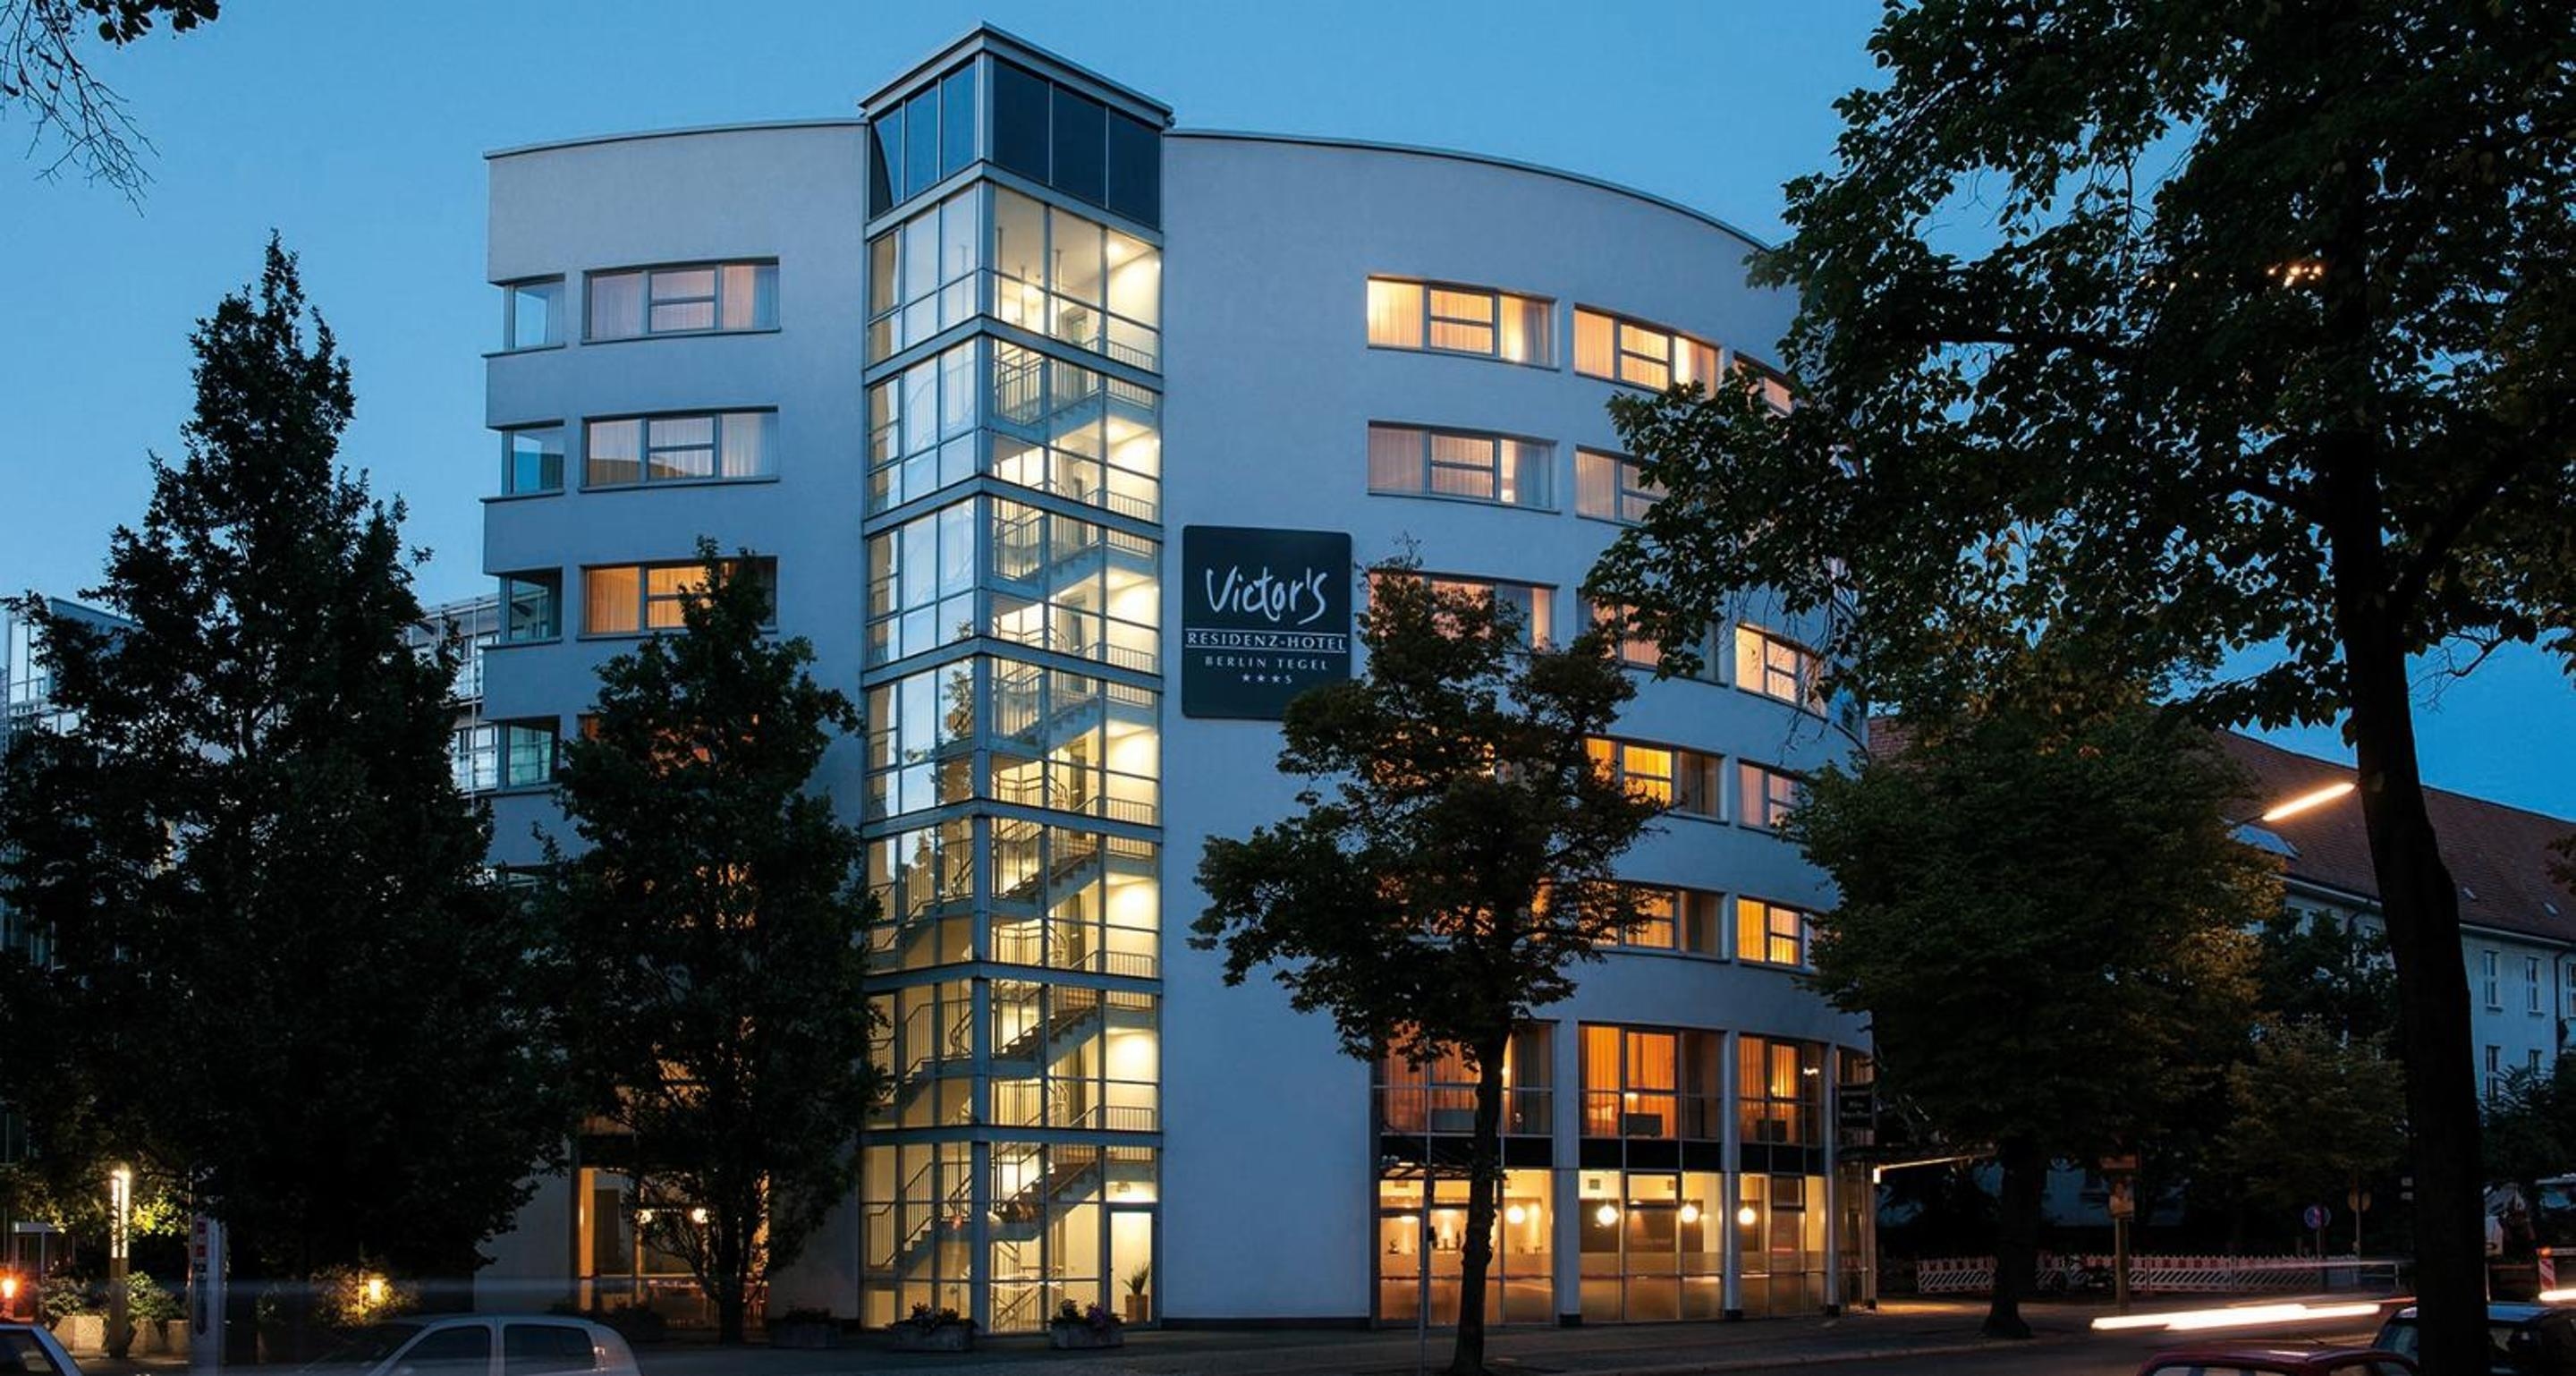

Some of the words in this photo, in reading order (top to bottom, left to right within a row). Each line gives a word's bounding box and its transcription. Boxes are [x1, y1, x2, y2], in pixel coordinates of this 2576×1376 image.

[1206, 565, 1328, 625] Victor's
[1187, 632, 1346, 650] RESIDENZ-HOTEL
[1205, 656, 1267, 668] BERLIN
[1277, 658, 1328, 670] TEGEL
